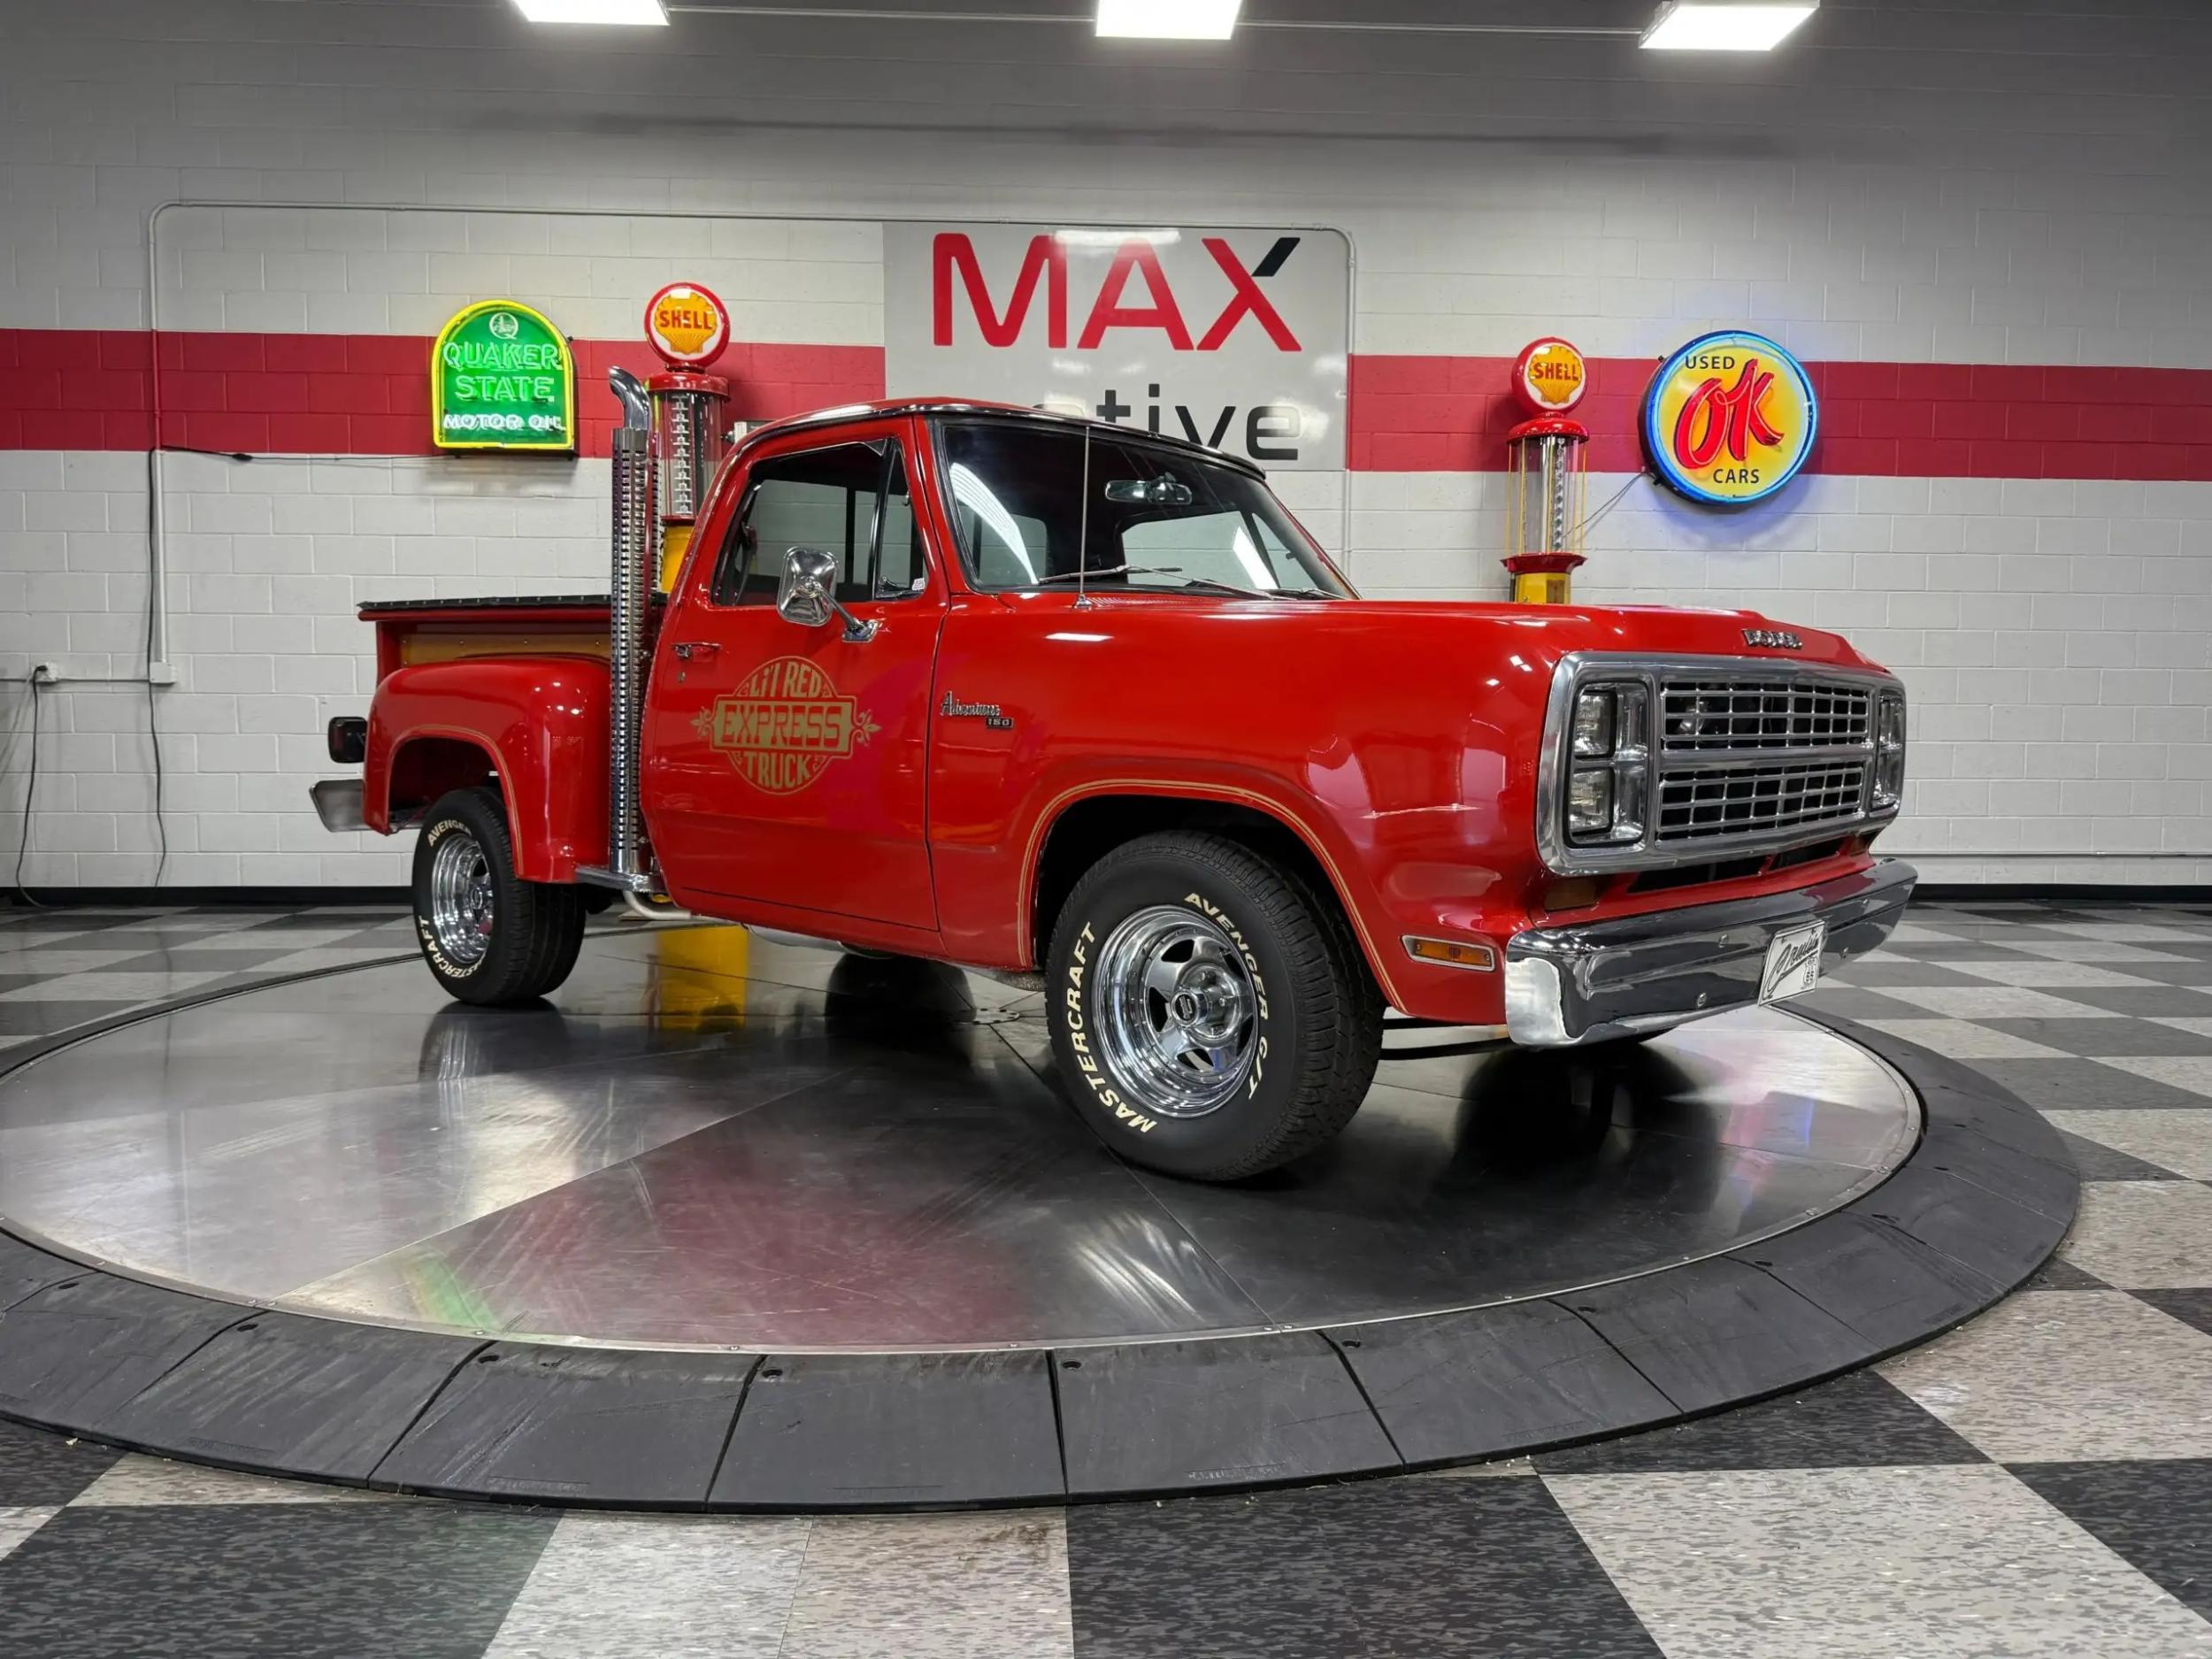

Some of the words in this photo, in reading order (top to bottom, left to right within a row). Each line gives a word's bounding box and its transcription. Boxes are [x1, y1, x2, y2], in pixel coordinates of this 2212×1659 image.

[933, 233, 1302, 351] MAX
[658, 310, 712, 330] SHELL
[443, 341, 564, 372] QUAKER
[1533, 362, 1579, 381] SHELL
[1685, 356, 1735, 370] USED
[455, 375, 556, 403] STATE
[443, 413, 526, 432] MOTOR
[528, 414, 566, 432] OIL
[1674, 358, 1785, 469] OK
[1713, 468, 1760, 484] CARS
[782, 661, 822, 698] RED
[721, 703, 843, 749] EXPRESS
[743, 752, 812, 789] TRUCK
[1183, 892, 1269, 1020] AVENGER
[1067, 921, 1158, 1133] MASTERCRAFT
